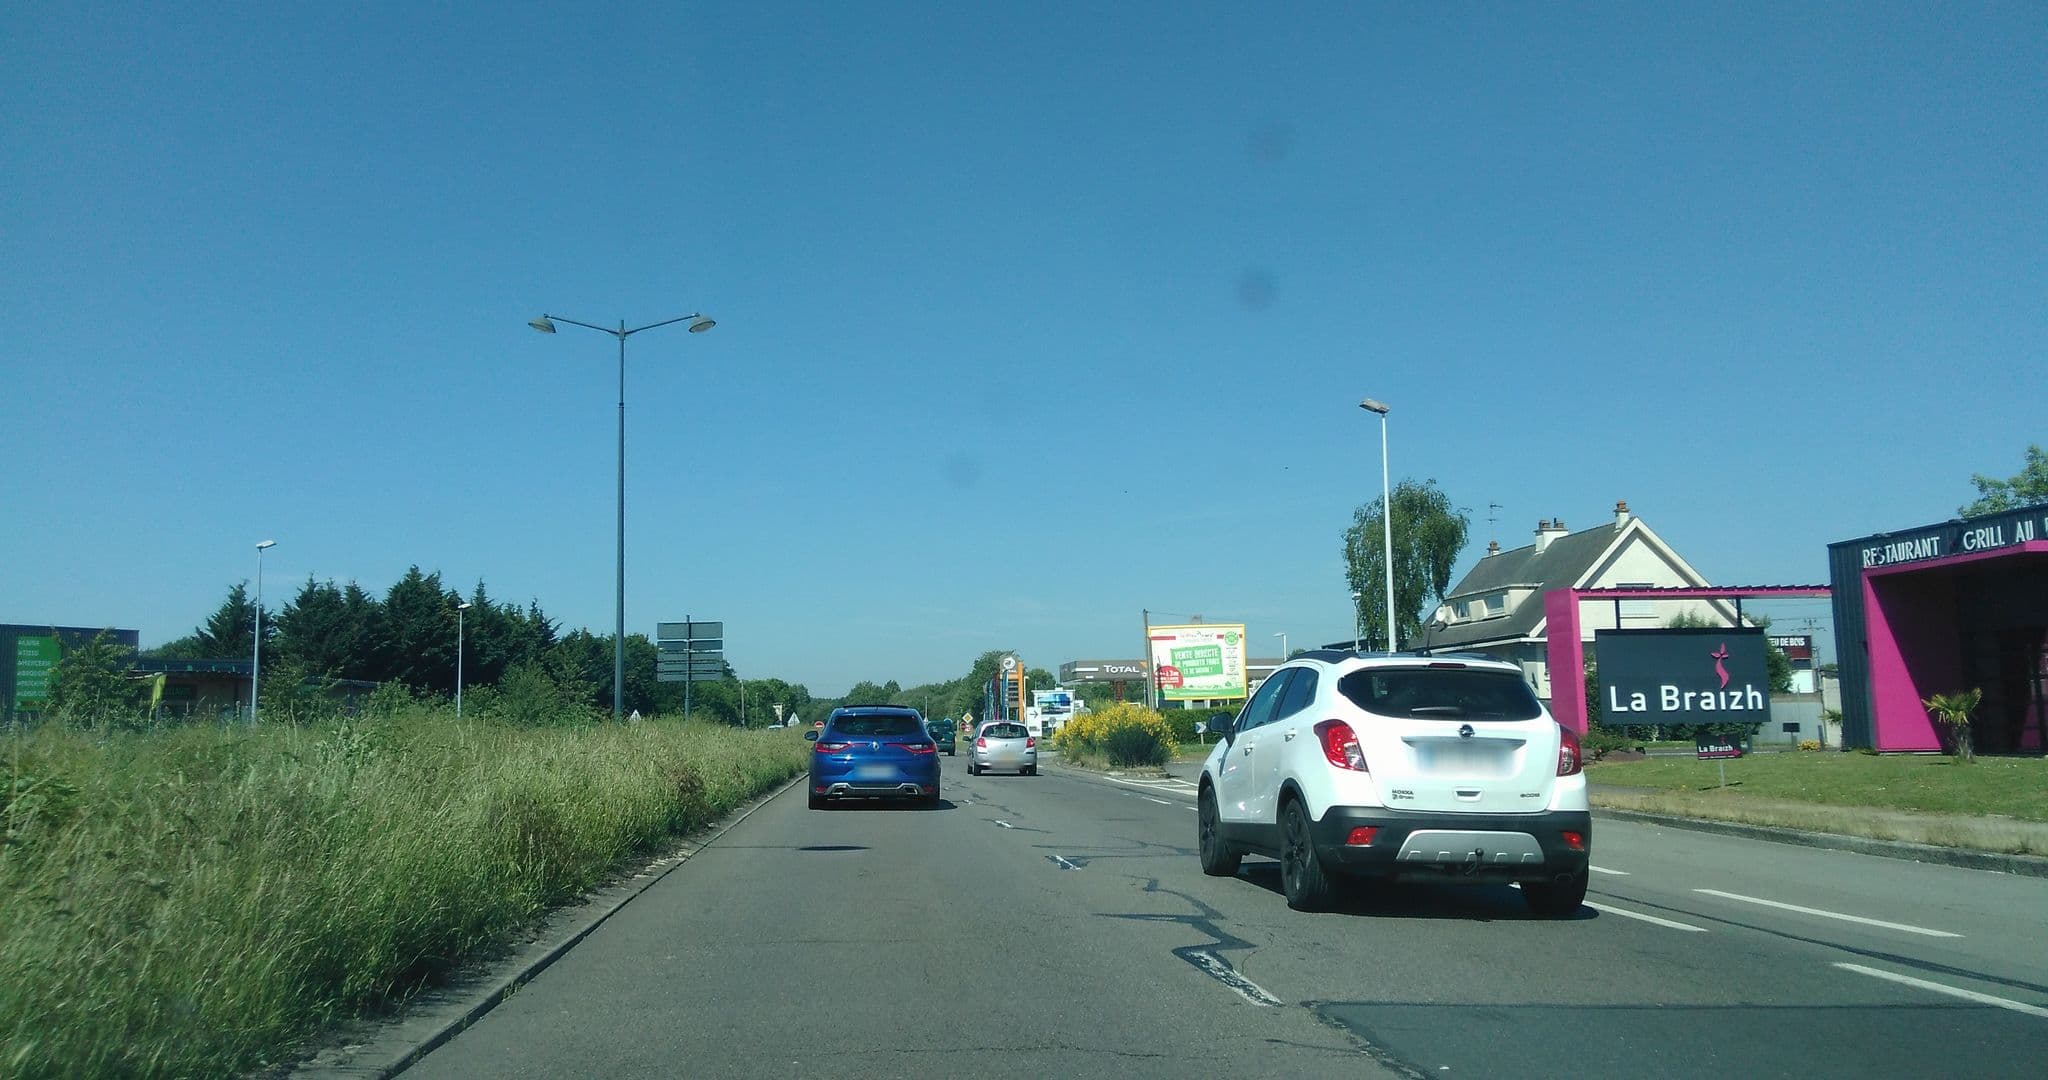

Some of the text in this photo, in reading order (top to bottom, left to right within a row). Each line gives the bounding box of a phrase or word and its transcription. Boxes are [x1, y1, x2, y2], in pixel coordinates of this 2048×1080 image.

[1863, 537, 1940, 568] RESTAURANT
[1963, 526, 2005, 550] GRILL
[2015, 520, 2034, 542] AU
[1780, 637, 1788, 646] DE
[1103, 665, 1140, 673] TOTAL
[1610, 684, 1763, 712] La Braizh
[1709, 744, 1733, 752] Braizh
